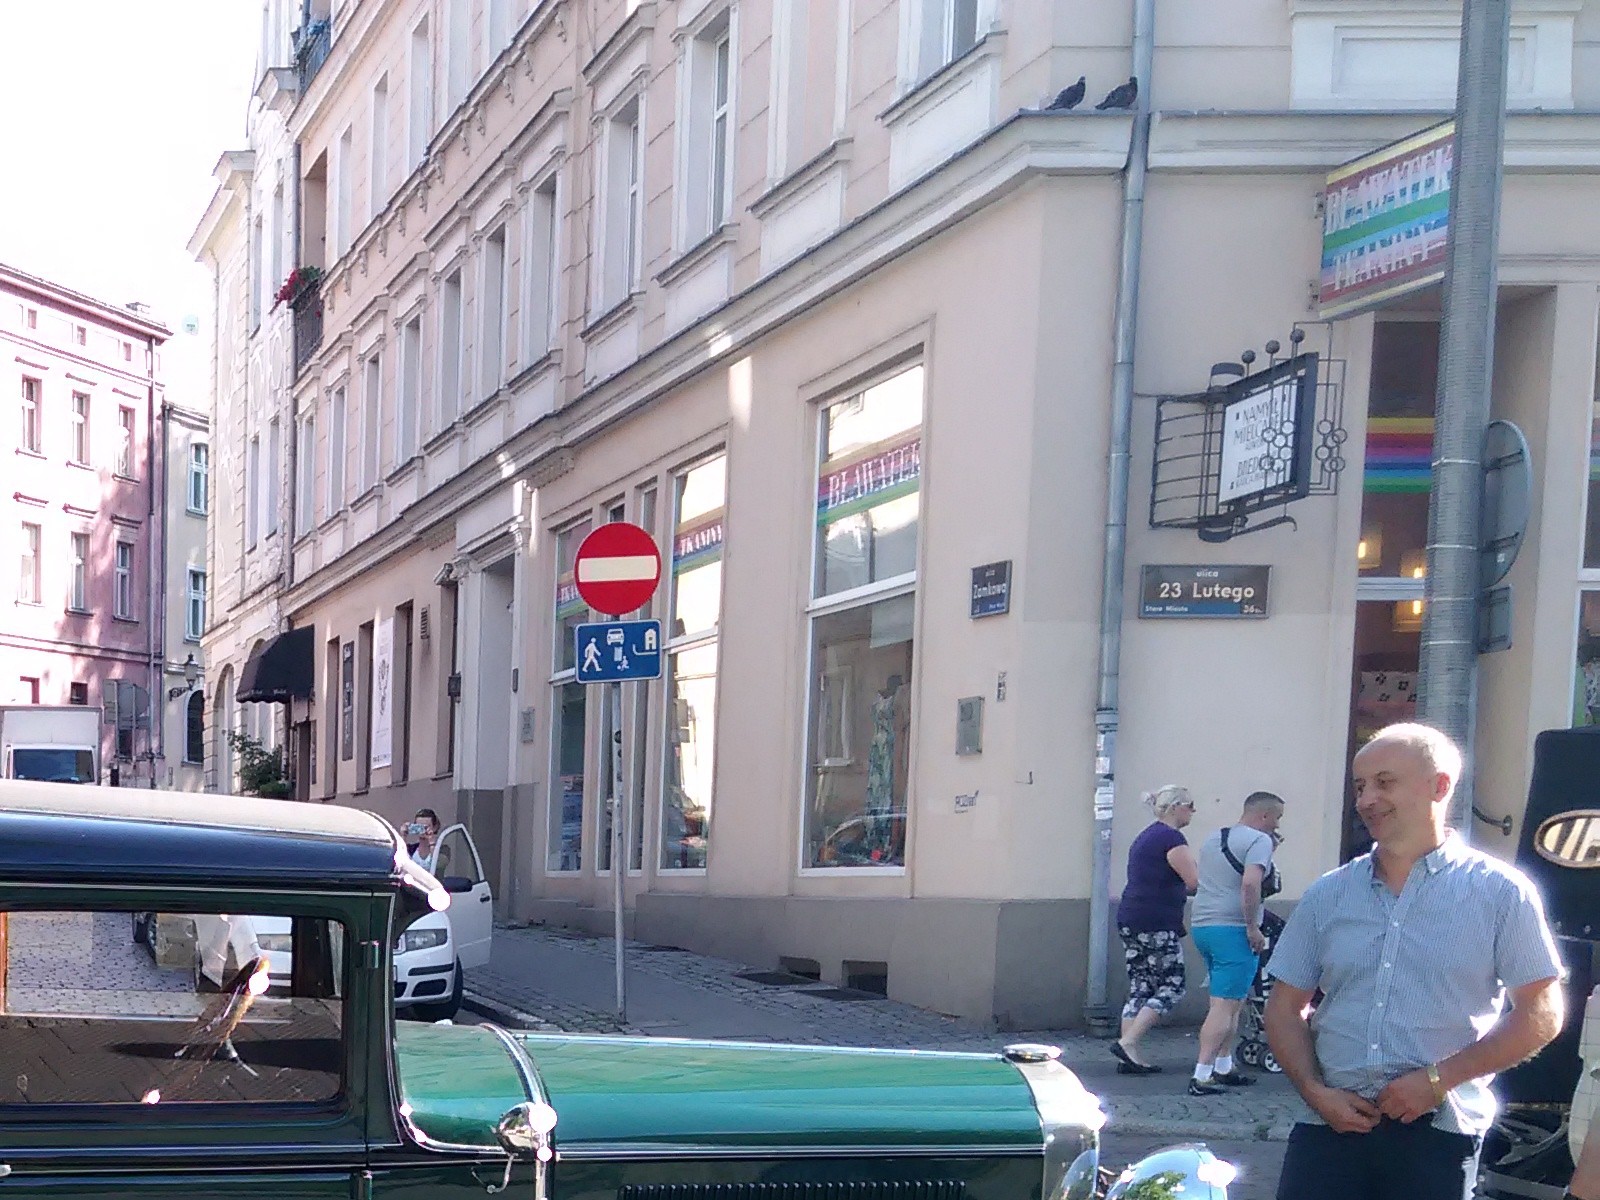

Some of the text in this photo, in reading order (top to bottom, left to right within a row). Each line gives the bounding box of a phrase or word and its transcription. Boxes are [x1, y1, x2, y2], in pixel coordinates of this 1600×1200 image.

[1196, 569, 1219, 577] ulica
[973, 581, 1007, 599] Zamkowa
[1159, 582, 1255, 603] 23 Lutego
